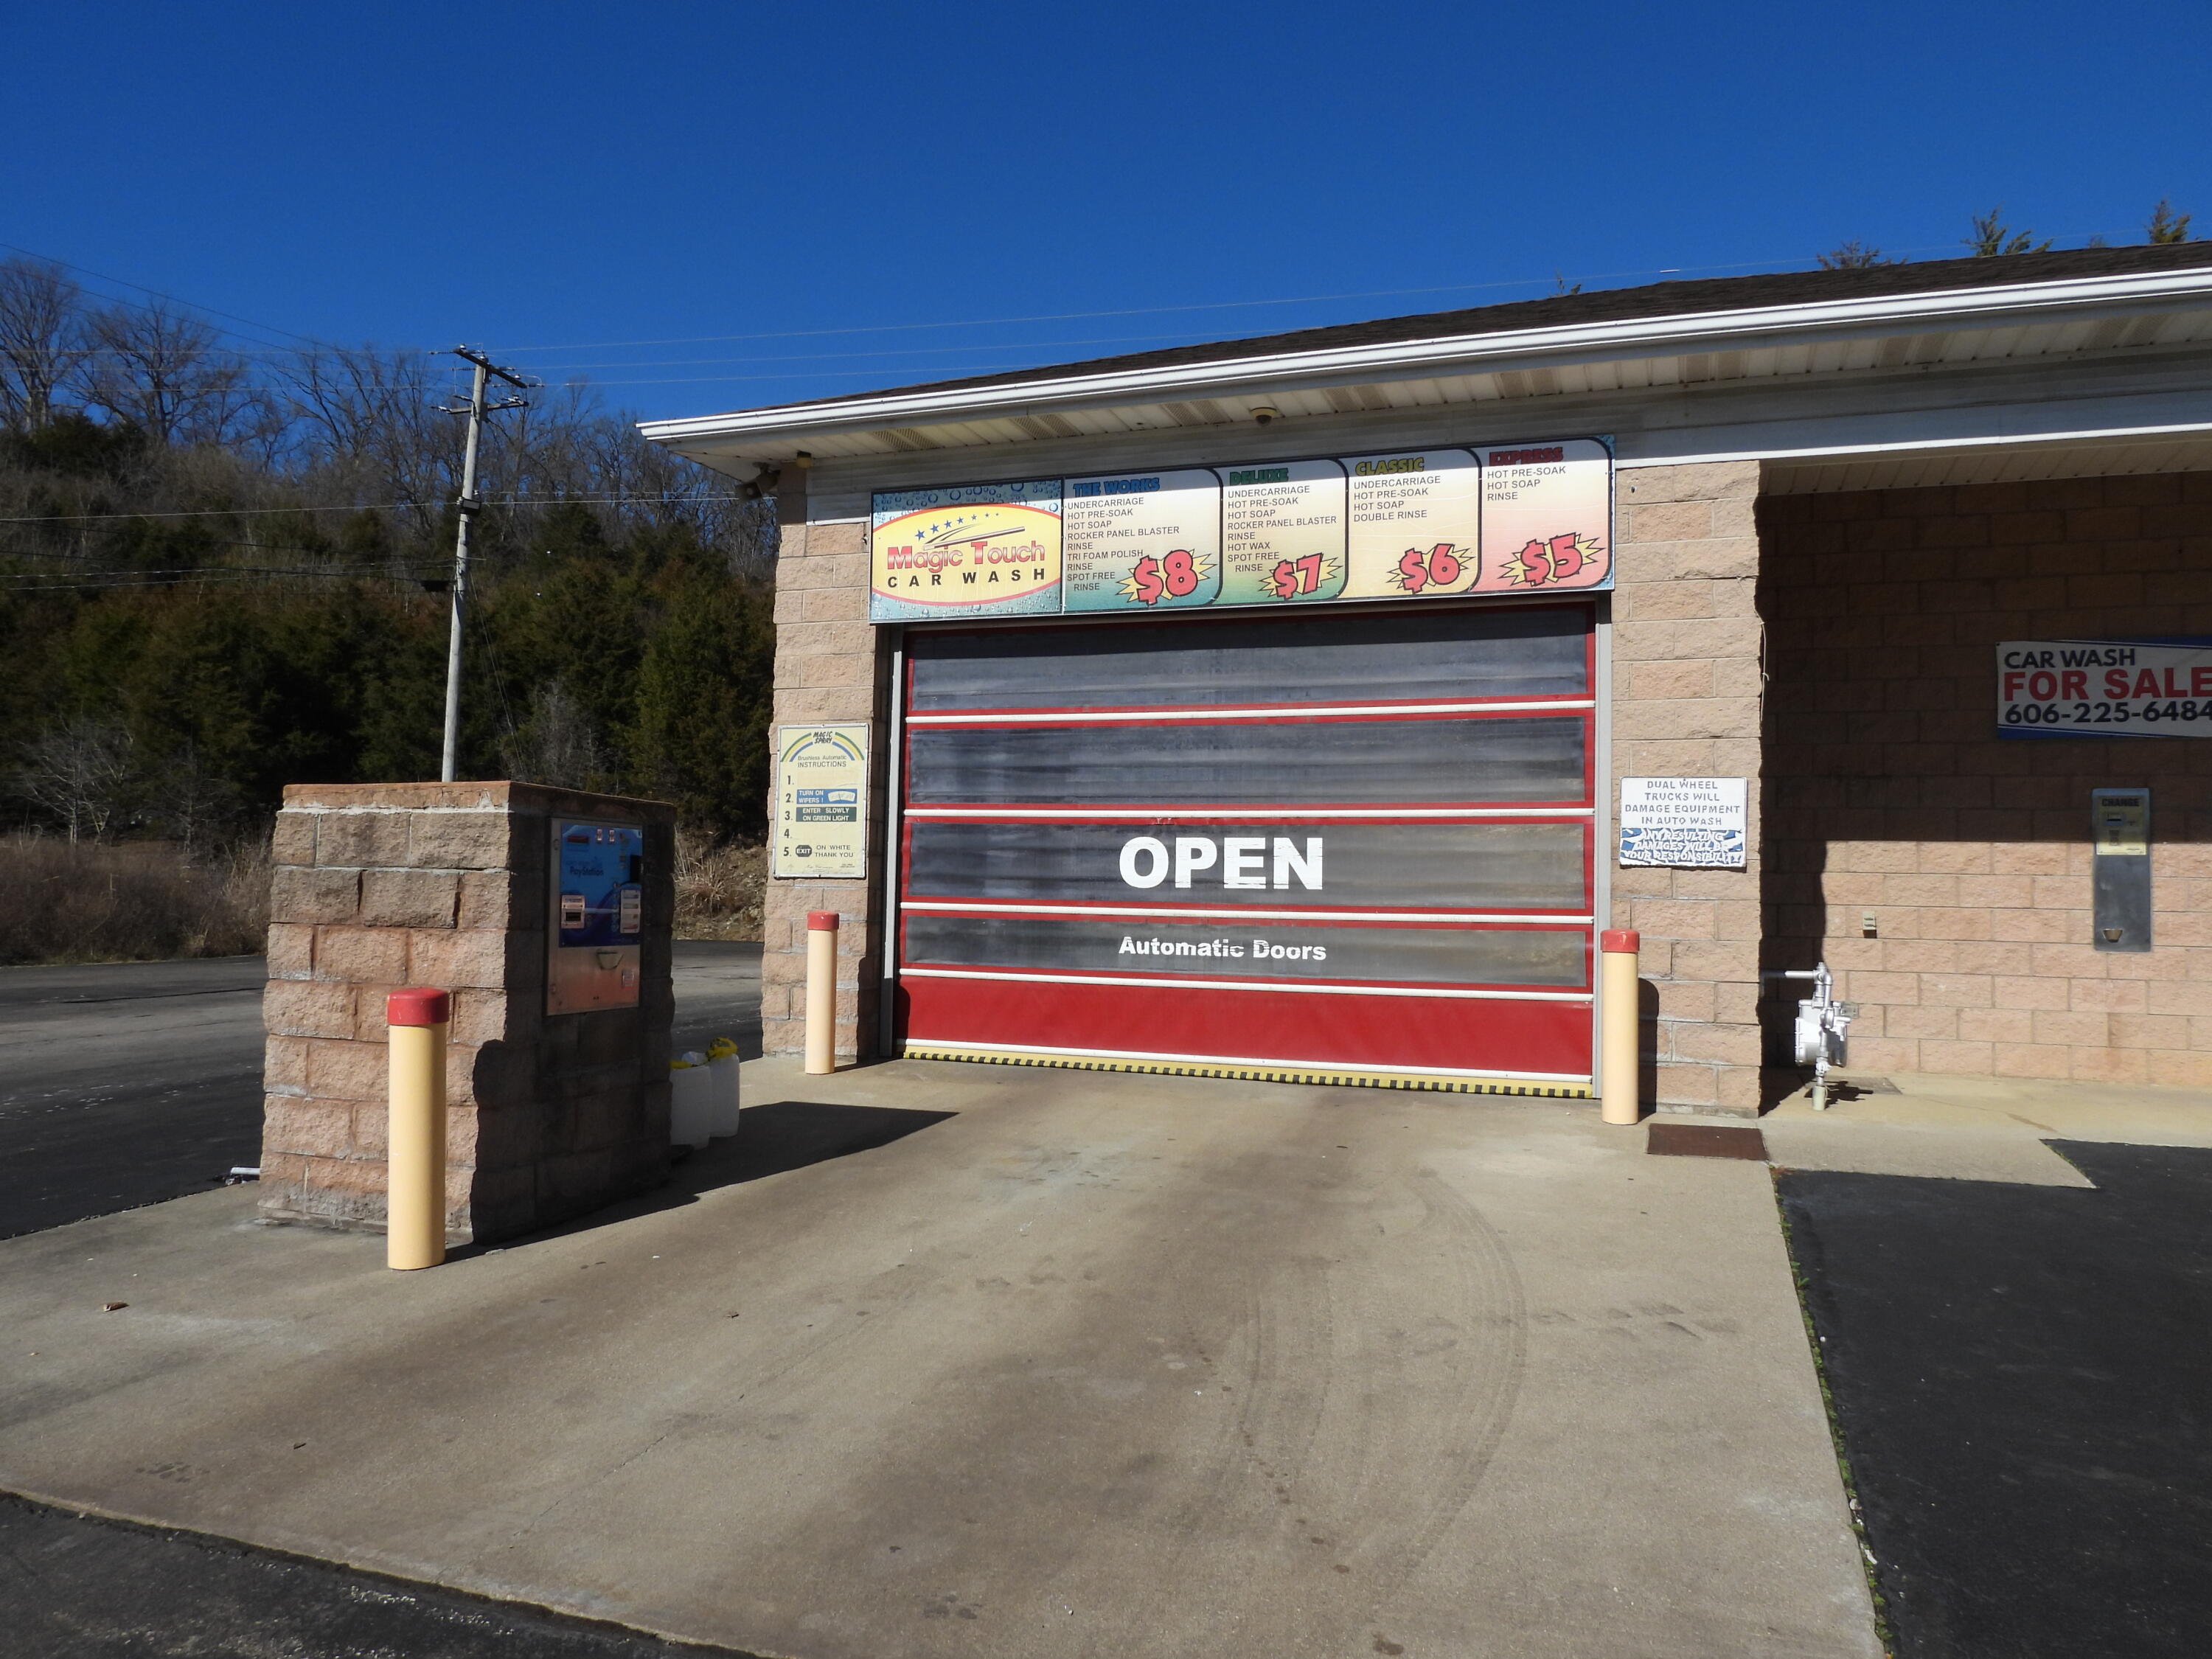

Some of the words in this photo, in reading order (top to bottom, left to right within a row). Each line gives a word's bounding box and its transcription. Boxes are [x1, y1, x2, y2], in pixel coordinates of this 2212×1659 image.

[1489, 447, 1563, 466] EXPRESS
[1355, 457, 1425, 476] CLASSIC
[1487, 470, 1509, 479] HOT
[1512, 466, 1566, 477] PRE-SOAK
[1229, 467, 1288, 485] DELUXE
[1074, 482, 1101, 497] THE
[1104, 478, 1160, 494] WORKS
[1354, 476, 1441, 489] UNDERCARRIAGE
[1487, 481, 1509, 490] HOT
[1512, 479, 1540, 488] SOAP
[1228, 486, 1310, 498] UNDERCARRIAGE
[1354, 492, 1374, 500] HOT
[1377, 487, 1428, 498] PRE-SOAK
[1487, 492, 1518, 501] RINSE
[1068, 498, 1144, 509] UNDERCARRIAGE
[1228, 501, 1247, 509] HOT
[1250, 497, 1298, 507] PRE-SOAK
[1354, 503, 1374, 511] HOT
[1377, 501, 1404, 509] SOAP
[1068, 512, 1085, 520] HOT
[1088, 509, 1133, 518] PRE-SOAK
[1228, 512, 1247, 520] HOT
[1250, 509, 1276, 518] SOAP
[1354, 512, 1394, 522] DOUBLE
[1397, 510, 1427, 519] RINSE
[1088, 521, 1112, 529] SOAP
[1228, 521, 1264, 530] ROCKER
[1266, 518, 1294, 528] PANEL
[1296, 516, 1337, 526] BLASTER
[1068, 531, 1104, 540] ROCKER
[1107, 529, 1135, 538] PANEL
[1138, 526, 1180, 536] BLASTER
[1228, 532, 1255, 540] RINSE
[1068, 543, 1093, 551] RINSE
[1249, 542, 1270, 550] WAX
[887, 545, 963, 573] Magic
[971, 540, 1046, 565] Touch
[1068, 553, 1081, 561] TRI
[1083, 551, 1109, 560] FOAM
[1110, 549, 1143, 558] POLISH
[1228, 554, 1252, 562] SPOT
[1255, 552, 1279, 560] FREE
[1520, 532, 1582, 586] $5
[1068, 563, 1093, 571] RINSE
[1235, 563, 1263, 572] RINSE
[1399, 543, 1460, 594] $6
[887, 574, 942, 588] CAR
[962, 568, 1045, 584] WASH
[1067, 573, 1089, 581] SPOT
[1092, 571, 1116, 580] FREE
[1133, 549, 1198, 605] $8
[1273, 552, 1324, 600] $7
[1074, 582, 1100, 591] RINSE
[2004, 651, 2056, 669] CAR
[2059, 648, 2135, 667] WASH
[2004, 670, 2089, 701] FOR
[2104, 667, 2212, 700] SALE
[2004, 700, 2212, 724] 606-225-6484
[1647, 781, 1676, 789] DUAL
[1679, 781, 1718, 789] WHEEL
[1645, 793, 1688, 801] TRUCKS
[1693, 793, 1720, 801] WILL
[2102, 798, 2140, 807] CHANGE
[1625, 804, 1670, 813] DAMAGE
[1674, 805, 1740, 814] EQUIPMENT
[1641, 816, 1652, 824] IN
[1690, 817, 1722, 825] WASH
[1119, 836, 1323, 890] OPEN
[1119, 936, 1245, 957] Automatic
[1253, 939, 1326, 961] Doors
